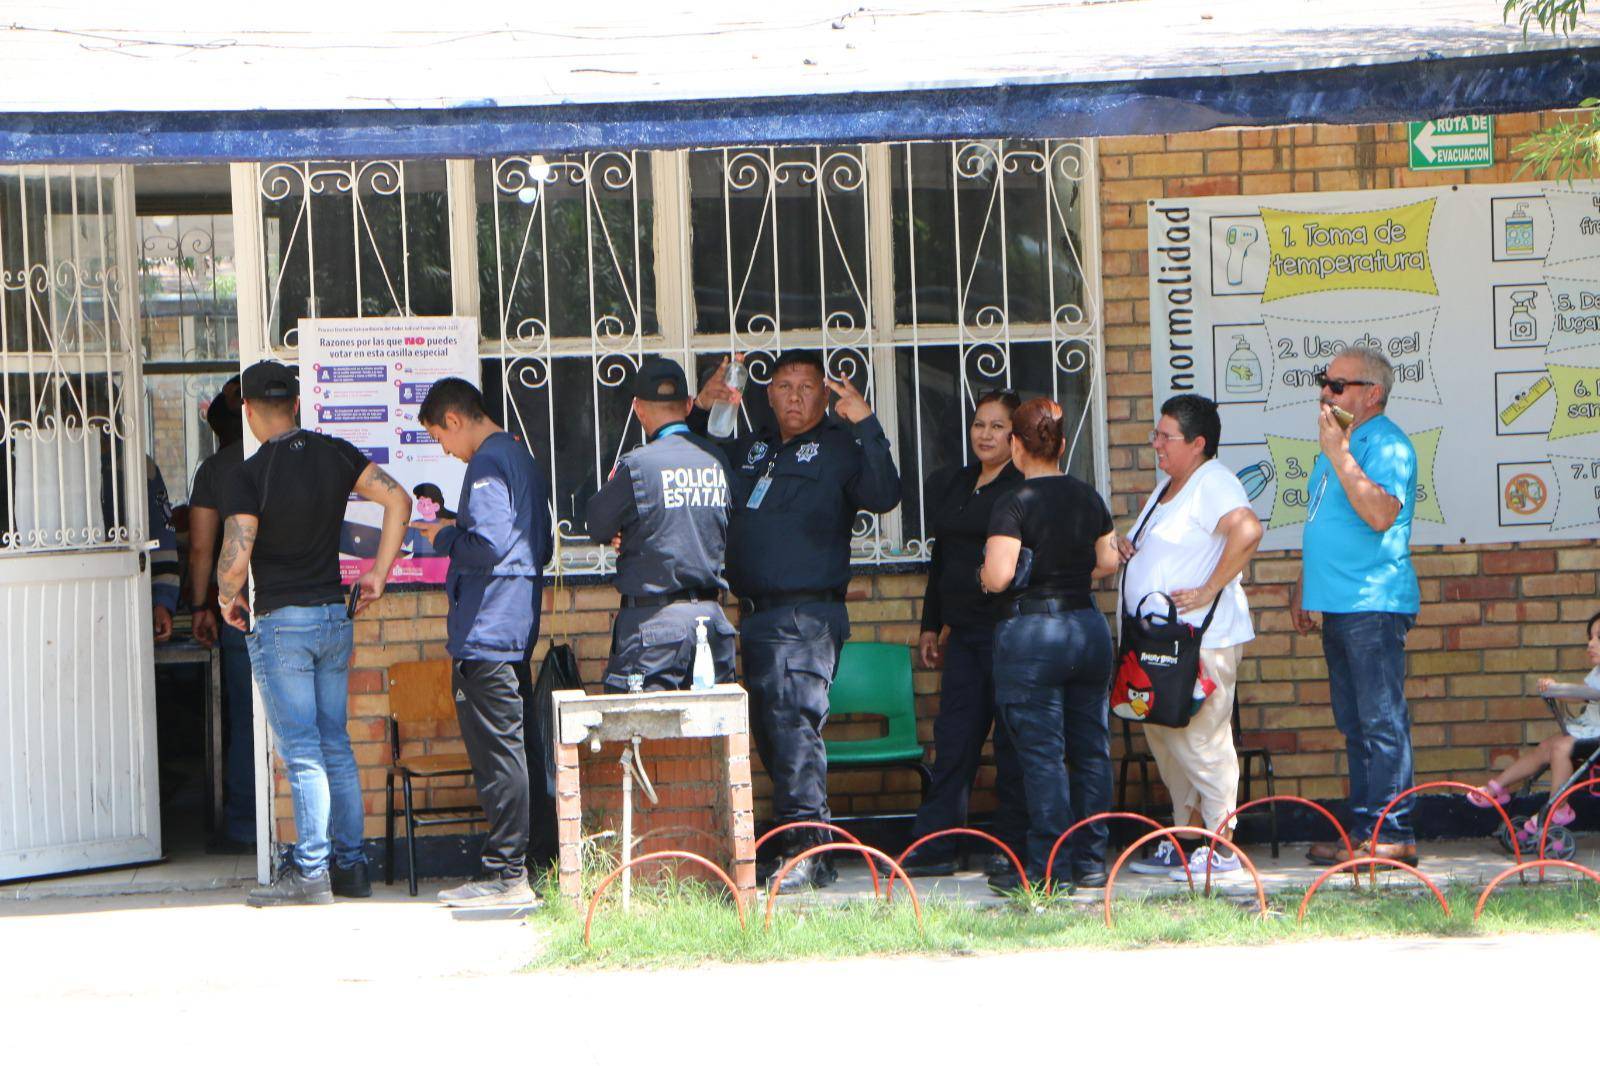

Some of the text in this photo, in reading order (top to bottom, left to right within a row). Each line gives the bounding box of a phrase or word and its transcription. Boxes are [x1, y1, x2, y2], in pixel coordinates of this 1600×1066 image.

[1437, 115, 1488, 132] RUTA DE
[1282, 218, 1406, 248] 1. Toma de
[1273, 249, 1425, 279] temperatura
[1155, 207, 1195, 390] normalidad
[1557, 294, 1576, 311] 5.
[320, 336, 458, 348] Razones por las que NO puedes
[1277, 338, 1299, 359] 2.
[1303, 335, 1347, 359] Uso
[1387, 331, 1420, 358] gel
[329, 347, 448, 359] votar en esta casilla especial
[1574, 379, 1592, 398] 6.
[661, 463, 726, 490] POLICÍA
[1285, 456, 1308, 479] 3.
[1570, 463, 1588, 480] 7.
[663, 487, 727, 508] ESTATAL
